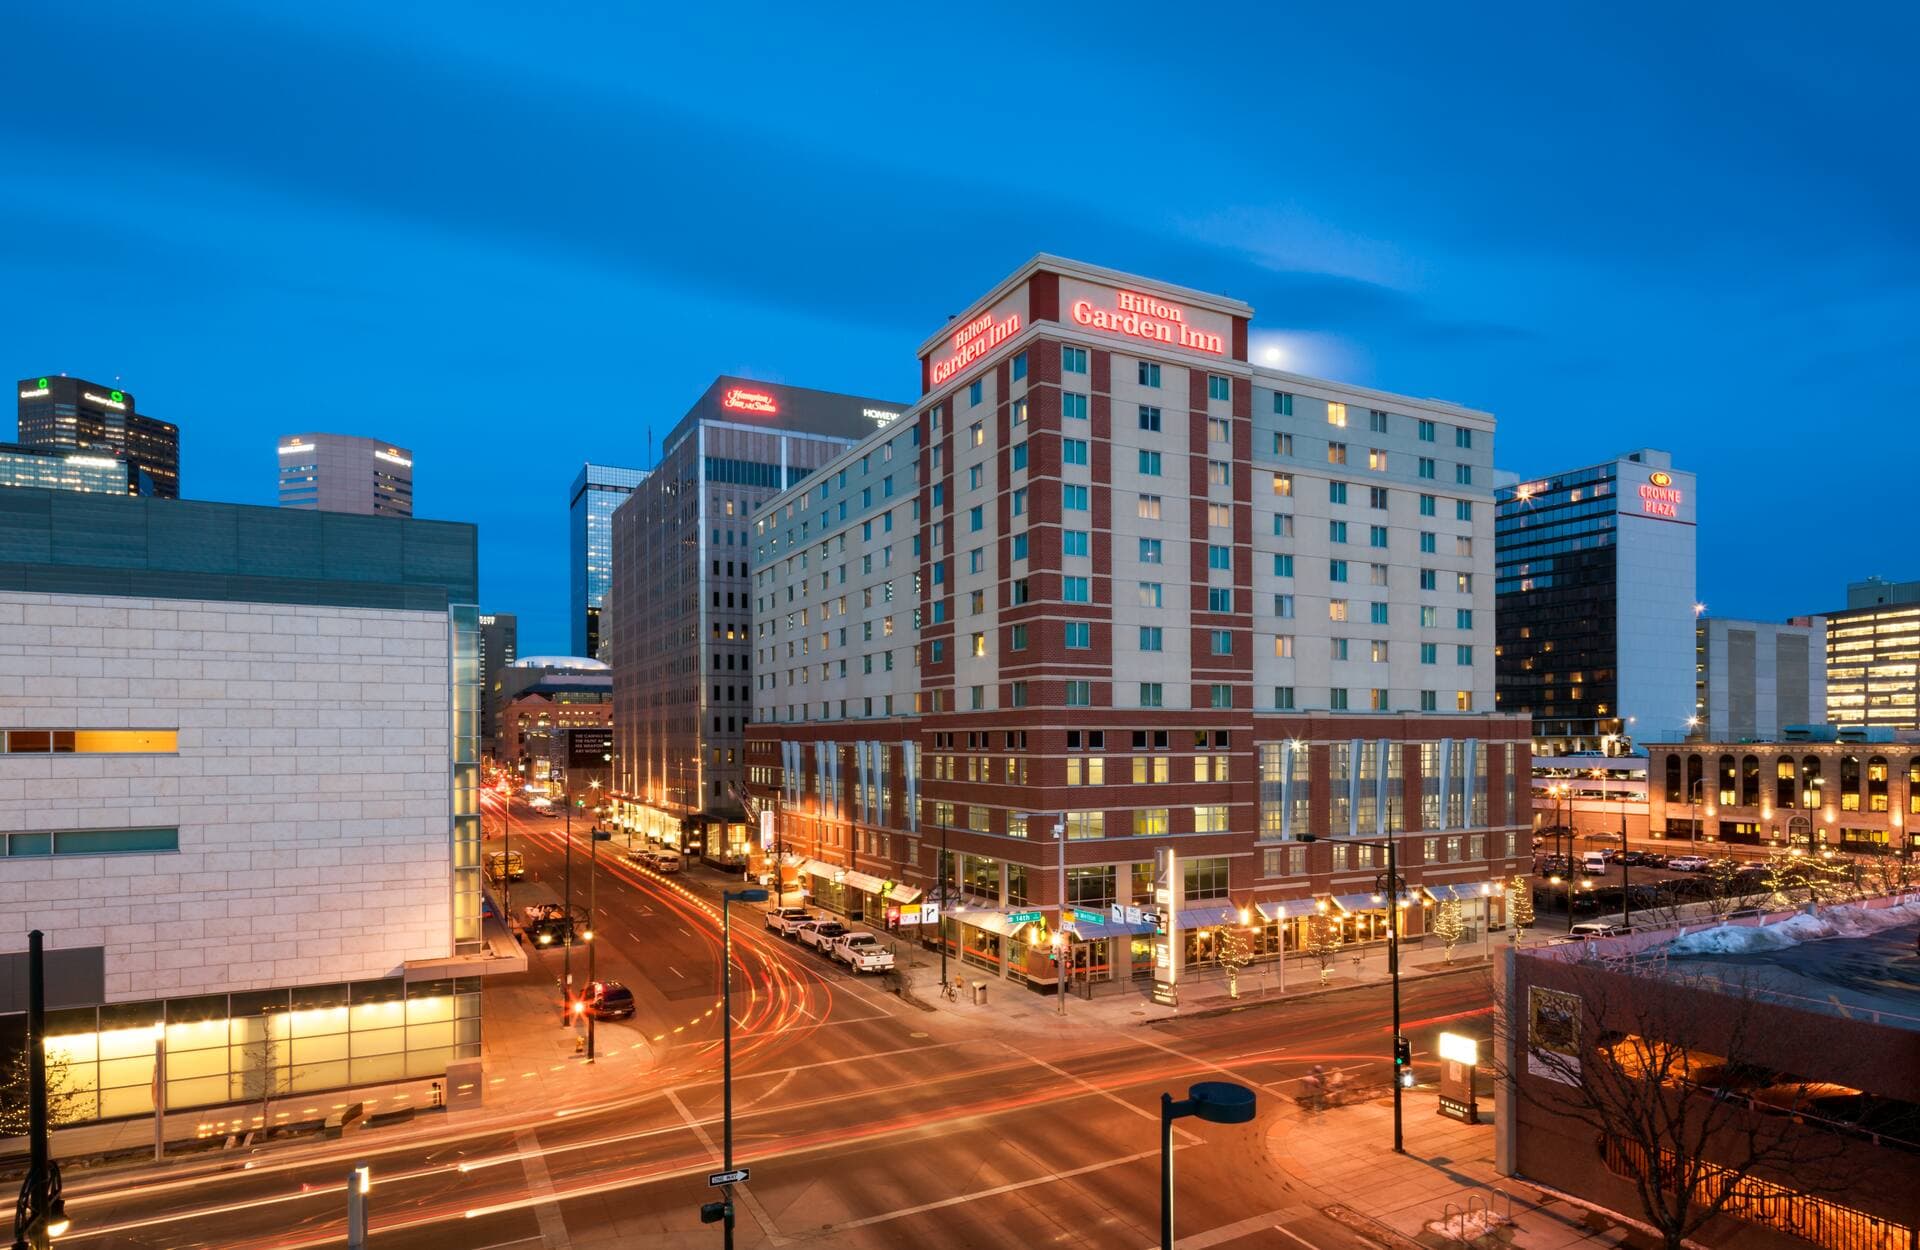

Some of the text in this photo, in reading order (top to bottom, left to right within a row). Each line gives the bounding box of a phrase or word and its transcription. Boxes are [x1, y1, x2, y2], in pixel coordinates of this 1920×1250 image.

[1118, 292, 1182, 322] Hilton
[956, 314, 992, 349] Hilton
[1073, 301, 1223, 353] Garden Inn
[933, 314, 1020, 385] Garden Inn
[728, 390, 772, 404] Hampton
[1639, 486, 1681, 503] CROWNE
[1644, 500, 1676, 517] PLAZA
[1015, 914, 1030, 922] 14th
[712, 1176, 723, 1184] ONE
